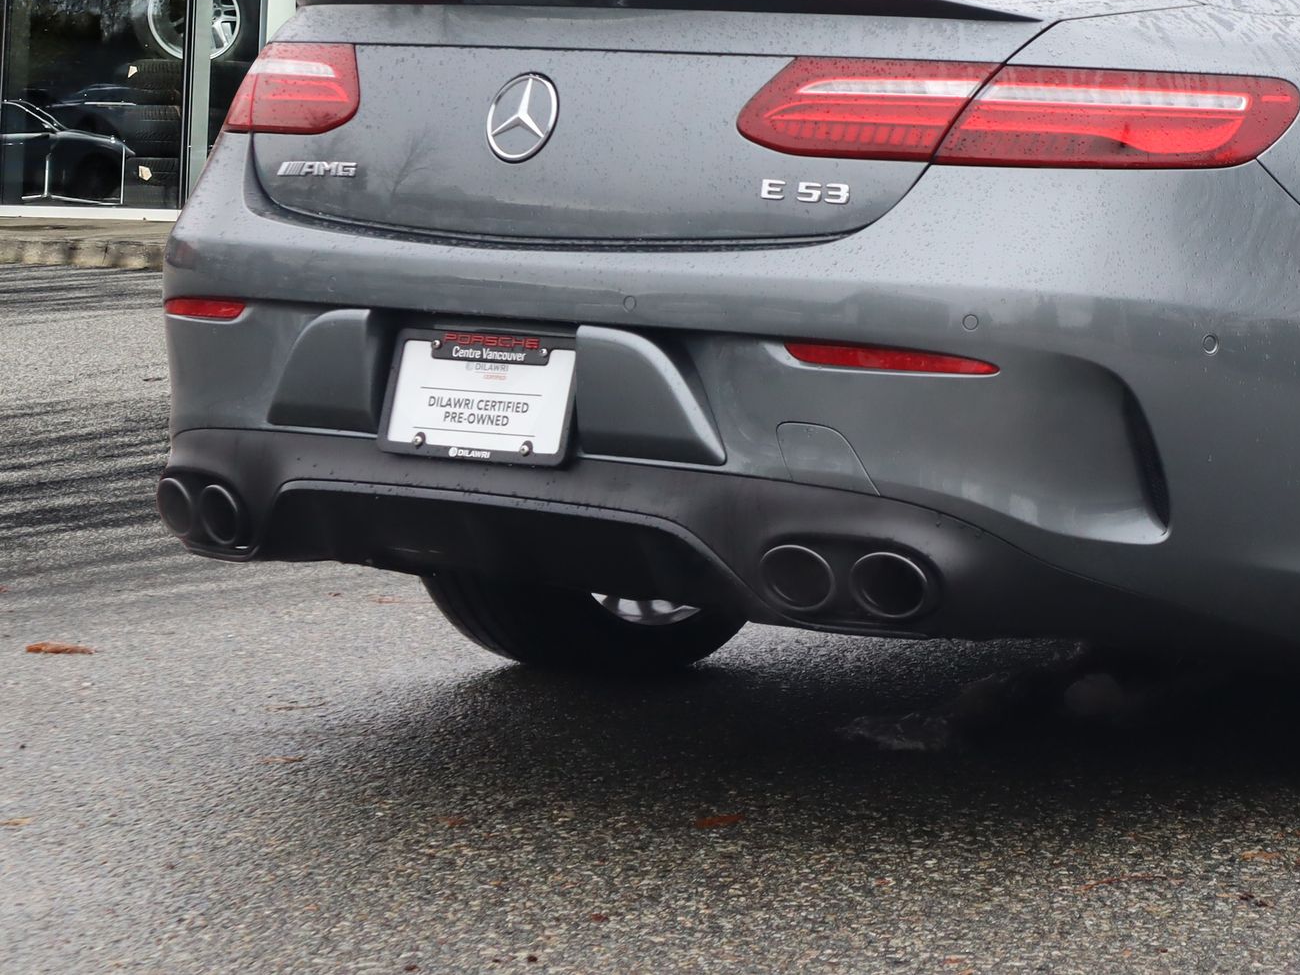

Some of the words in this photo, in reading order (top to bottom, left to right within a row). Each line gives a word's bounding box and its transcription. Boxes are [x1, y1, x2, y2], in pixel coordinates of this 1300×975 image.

[760, 178, 786, 200] E
[796, 182, 850, 204] 53
[443, 332, 541, 350] PORSCHE
[452, 345, 481, 359] Centre
[482, 348, 527, 362] Vancouver
[474, 362, 510, 372] DILAWRI
[428, 395, 474, 410] DILAWRI
[476, 399, 530, 414] CERTIFIED
[443, 411, 510, 427] PRE-OWNED
[457, 449, 491, 459] DILAWRI
